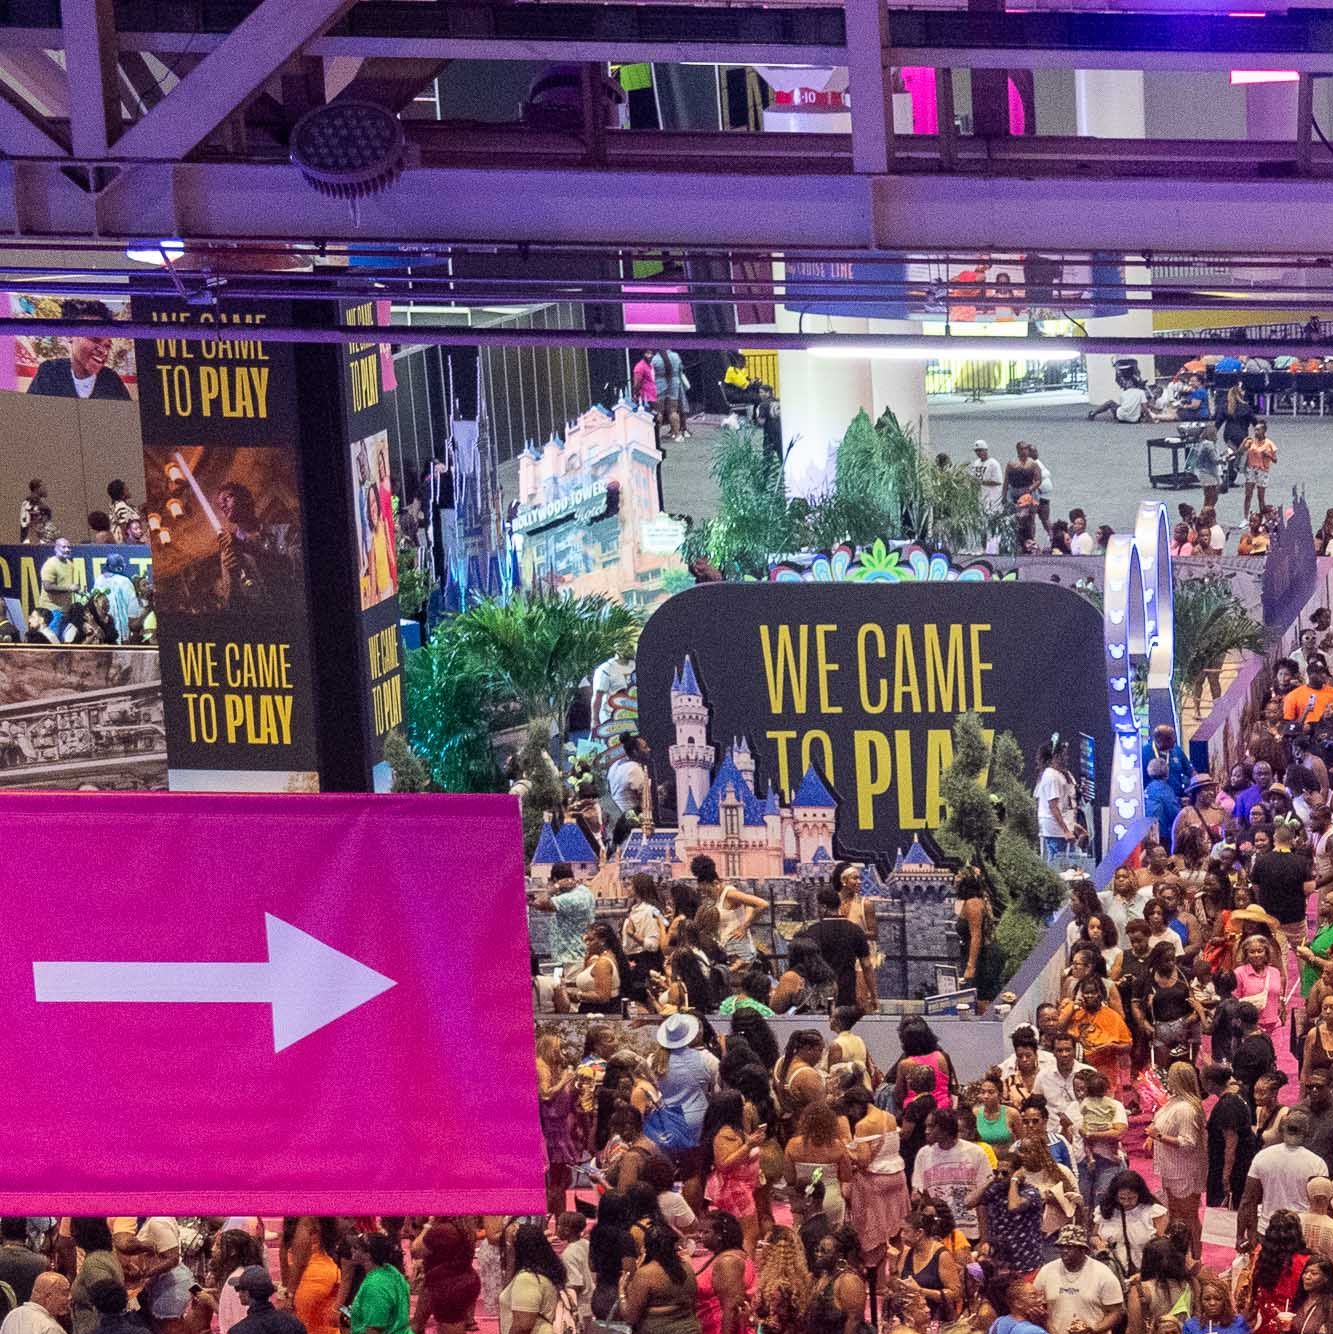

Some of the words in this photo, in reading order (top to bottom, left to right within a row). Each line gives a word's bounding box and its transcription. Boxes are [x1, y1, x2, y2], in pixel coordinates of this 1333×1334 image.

[154, 312, 194, 358] WE
[202, 312, 270, 360] CAME
[157, 365, 192, 417] TO
[199, 366, 269, 418] PLAY
[179, 641, 219, 689] WE
[224, 642, 294, 690] CAME
[759, 624, 843, 714] WE
[856, 623, 997, 715] CAME
[182, 693, 219, 743] TO
[224, 694, 294, 744] PLAY
[372, 686, 384, 736] TO
[383, 673, 403, 731] PLAY
[856, 730, 997, 831] PLA
